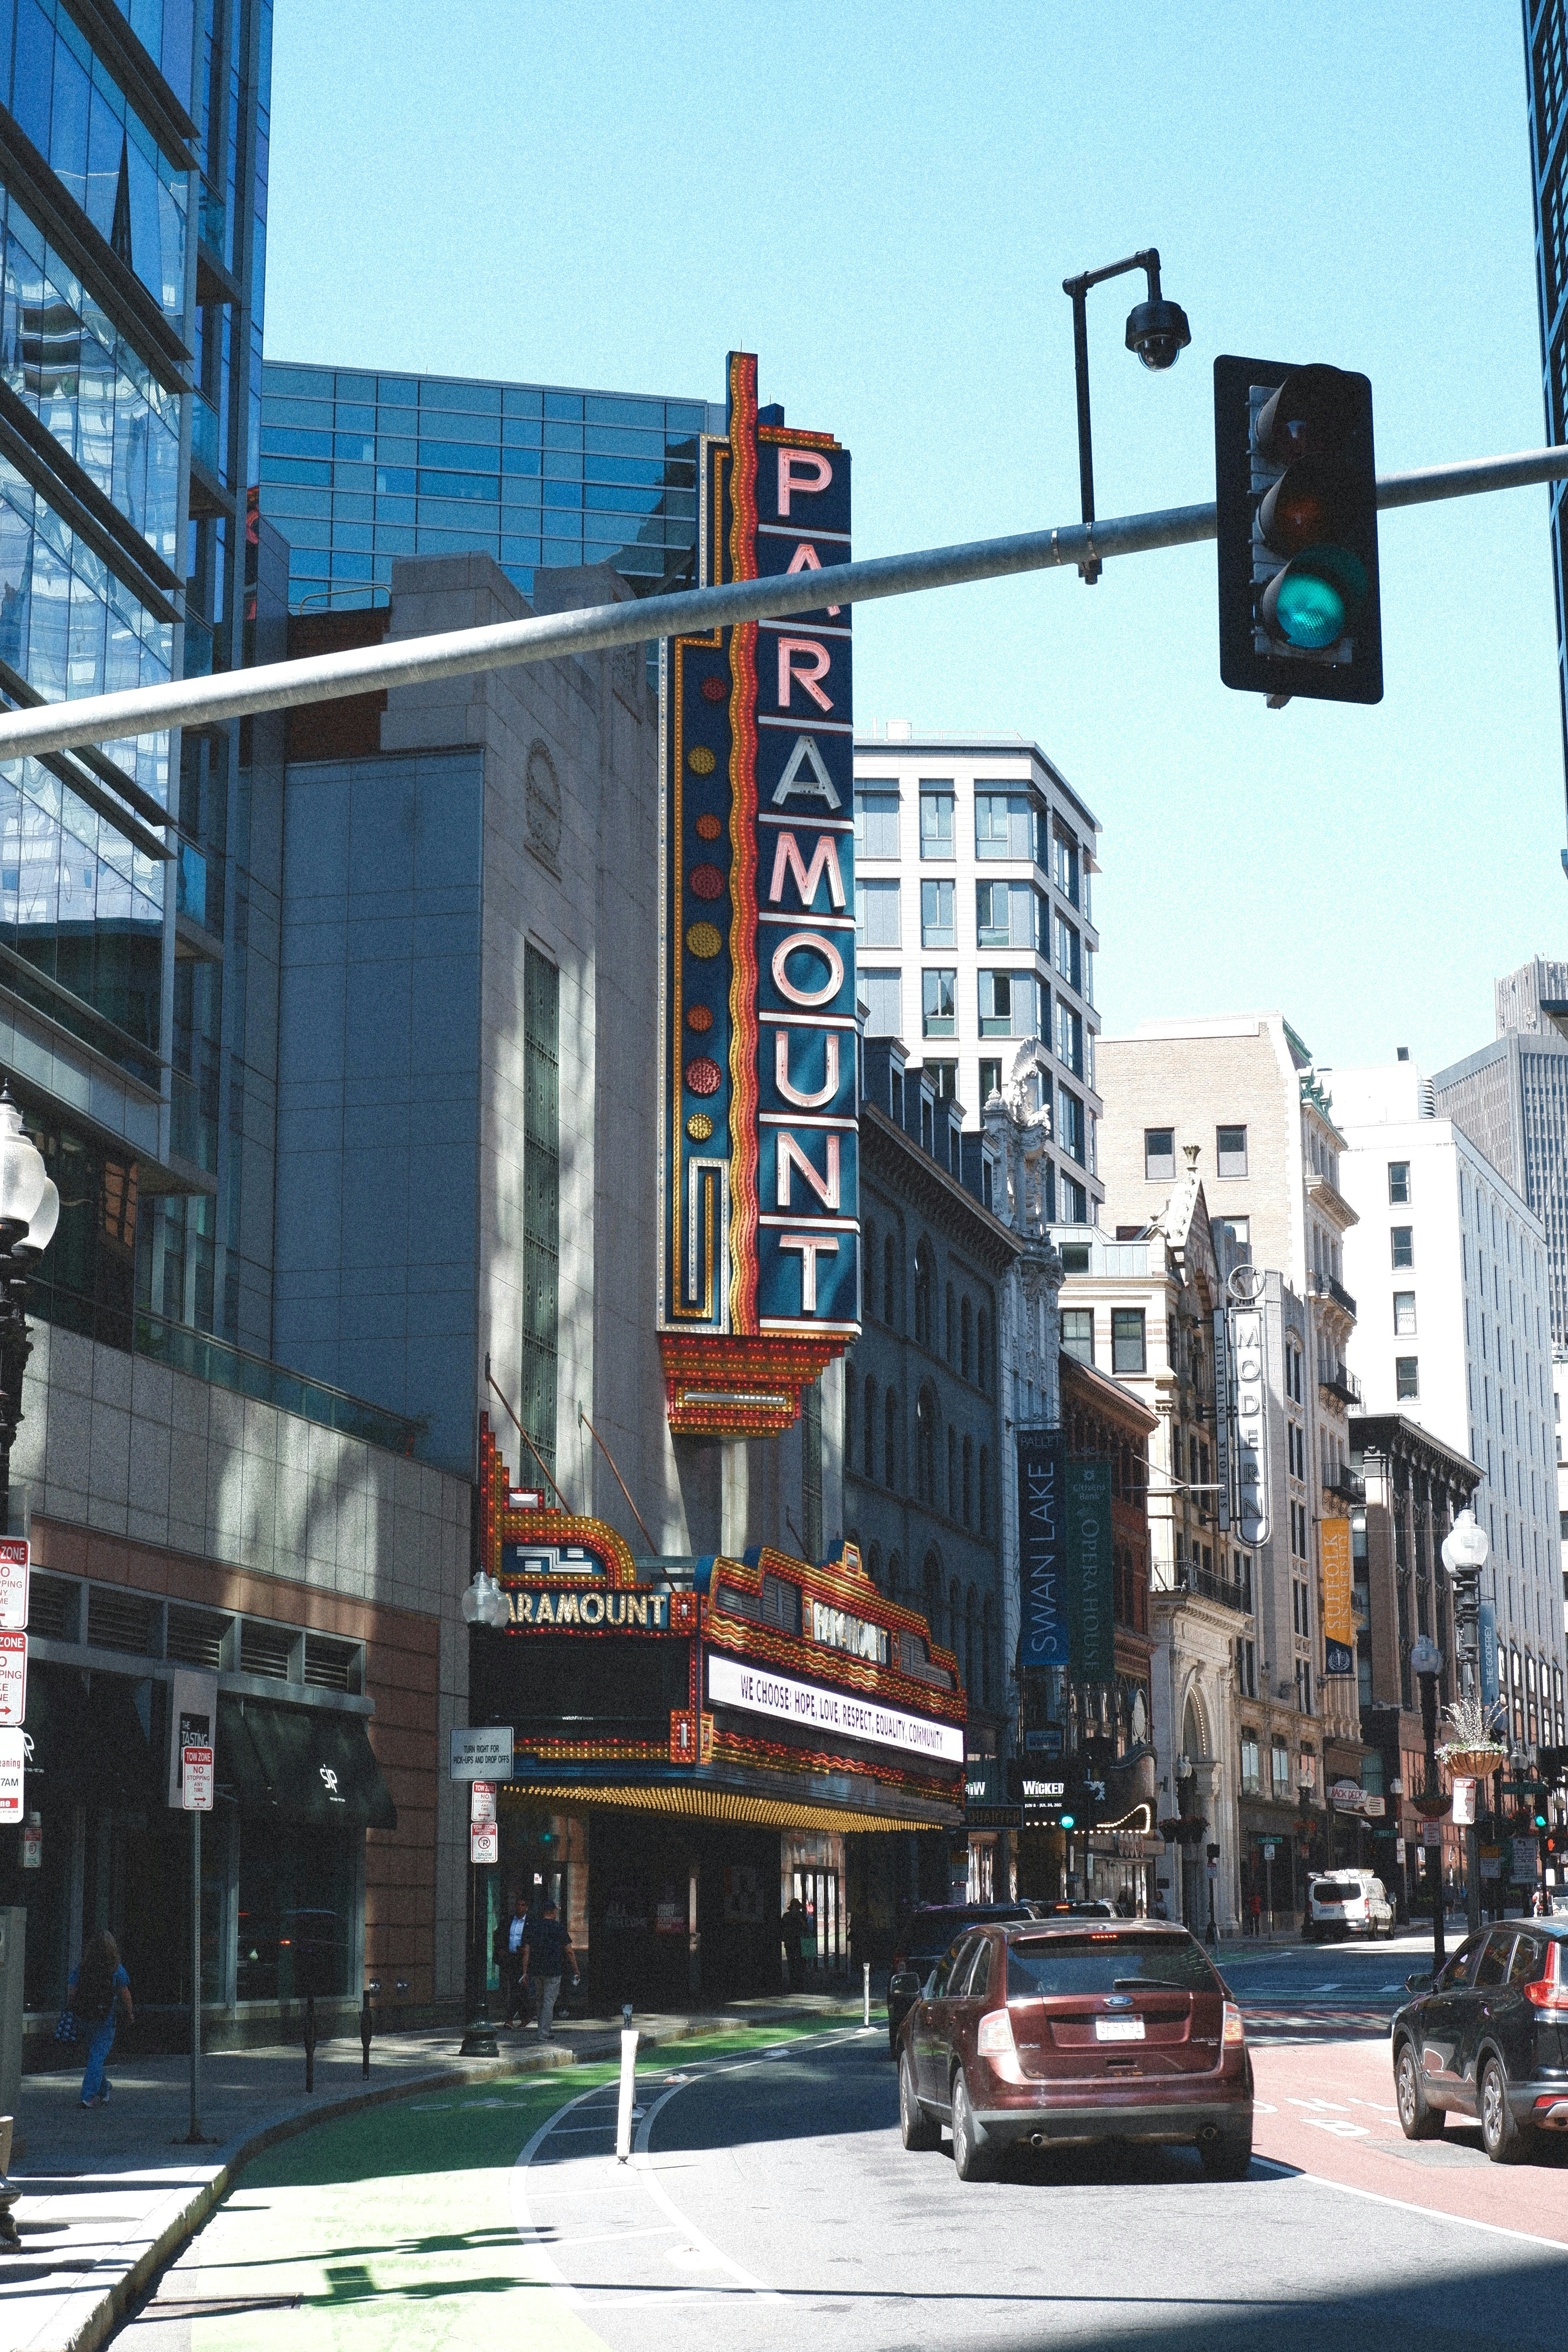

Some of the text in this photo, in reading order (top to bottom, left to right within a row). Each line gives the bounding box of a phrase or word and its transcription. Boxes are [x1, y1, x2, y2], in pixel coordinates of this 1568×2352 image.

[1216, 1335, 1226, 1426] UNIVERSITY
[1237, 1325, 1262, 1519] MODERN
[1021, 1435, 1060, 1448] BALLET
[0, 1547, 25, 1560] ZONE
[1028, 1461, 1058, 1652] SWAN LAKE
[0, 1567, 10, 1577] O
[1324, 1533, 1341, 1630] SUFFOLK
[1338, 1534, 1349, 1628] UNIVERSITY
[1081, 1518, 1099, 1670] OPERA HOUSE
[505, 1593, 666, 1625] RAMOUNT
[1484, 1625, 1493, 1666] GODFREY
[0, 1670, 22, 1679] PING
[741, 1674, 943, 1750] WE CHOOSE: HOPE, LOVE, RESPECT, EQUALITY, COMMUNITY
[182, 1720, 190, 1730] THE
[464, 1745, 499, 1753] TURN RIGHT FOR
[0, 1758, 21, 1769] eaning
[186, 1752, 197, 1761] TOW
[198, 1752, 211, 1762] ZONE
[453, 1755, 509, 1764] PICK-UPS AND DROP OFFS
[1331, 1788, 1363, 1799] BACK DECK
